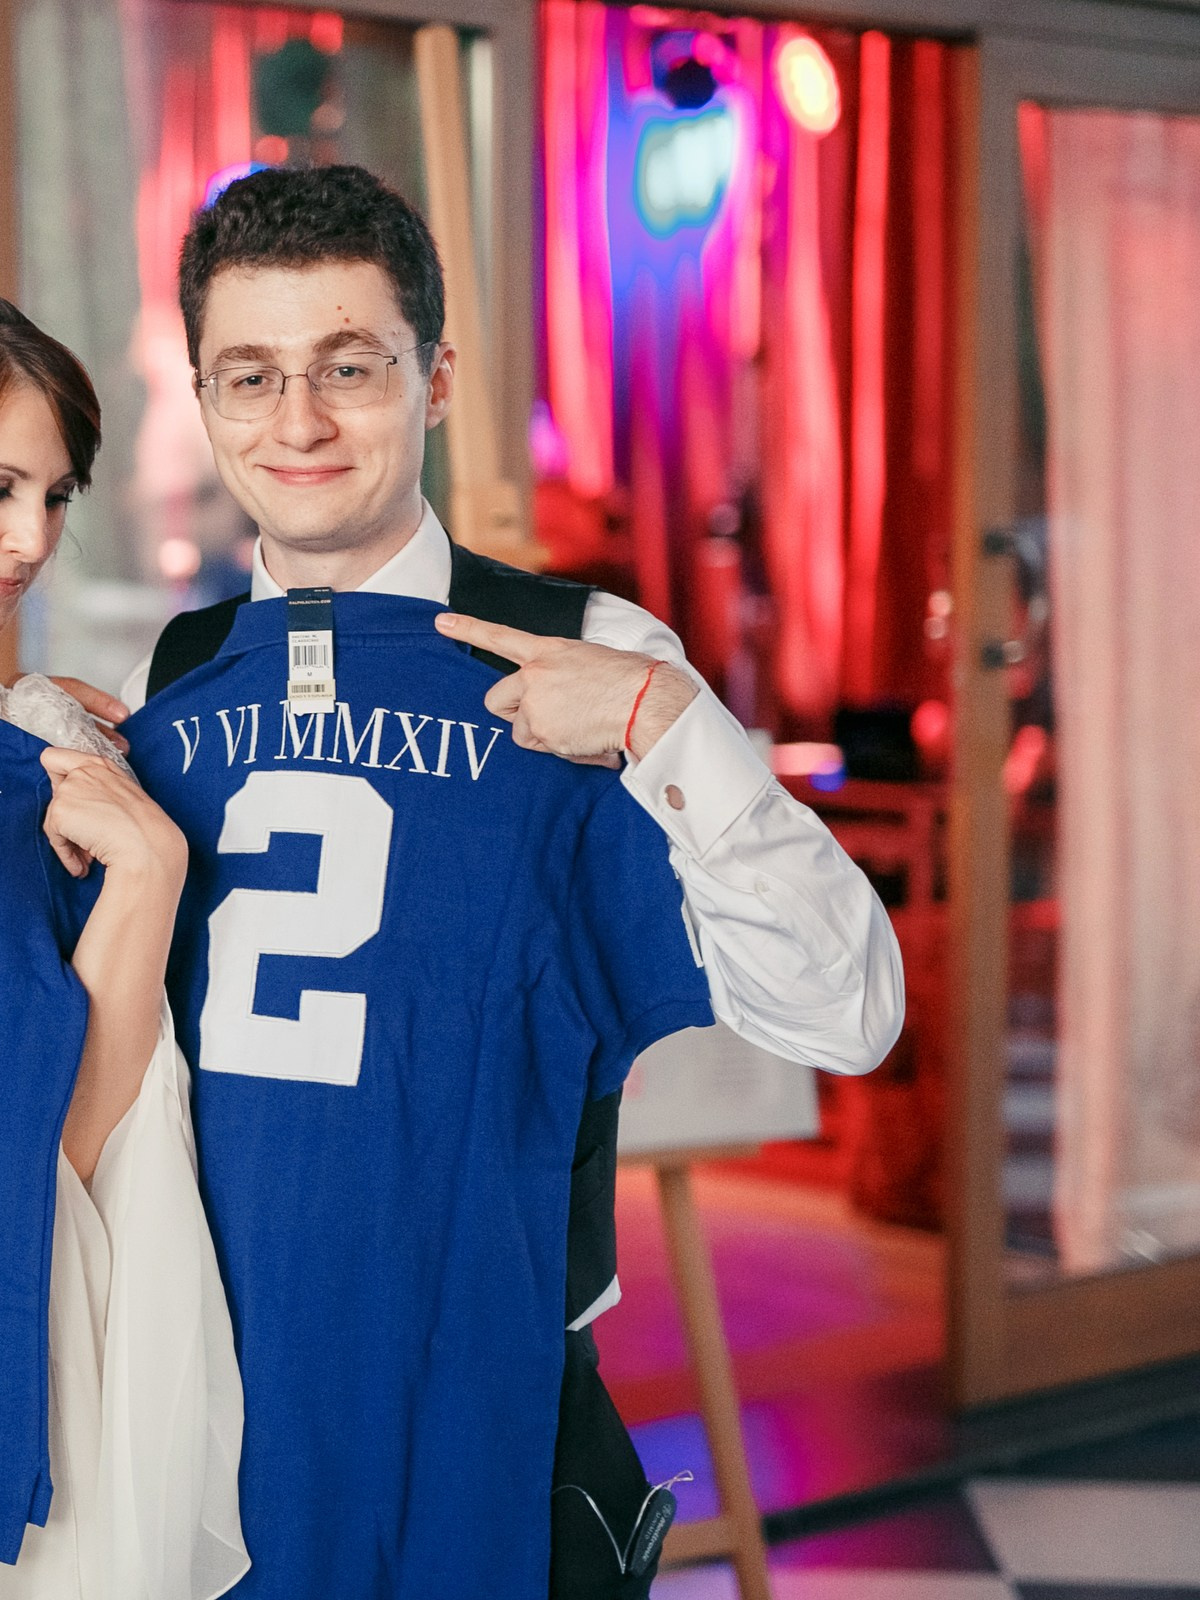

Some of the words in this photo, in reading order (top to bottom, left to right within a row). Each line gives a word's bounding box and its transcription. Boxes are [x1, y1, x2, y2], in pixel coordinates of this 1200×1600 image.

[172, 716, 200, 774] V
[216, 703, 262, 767] VI
[273, 700, 504, 781] MMXIV
[199, 770, 394, 1087] 2
